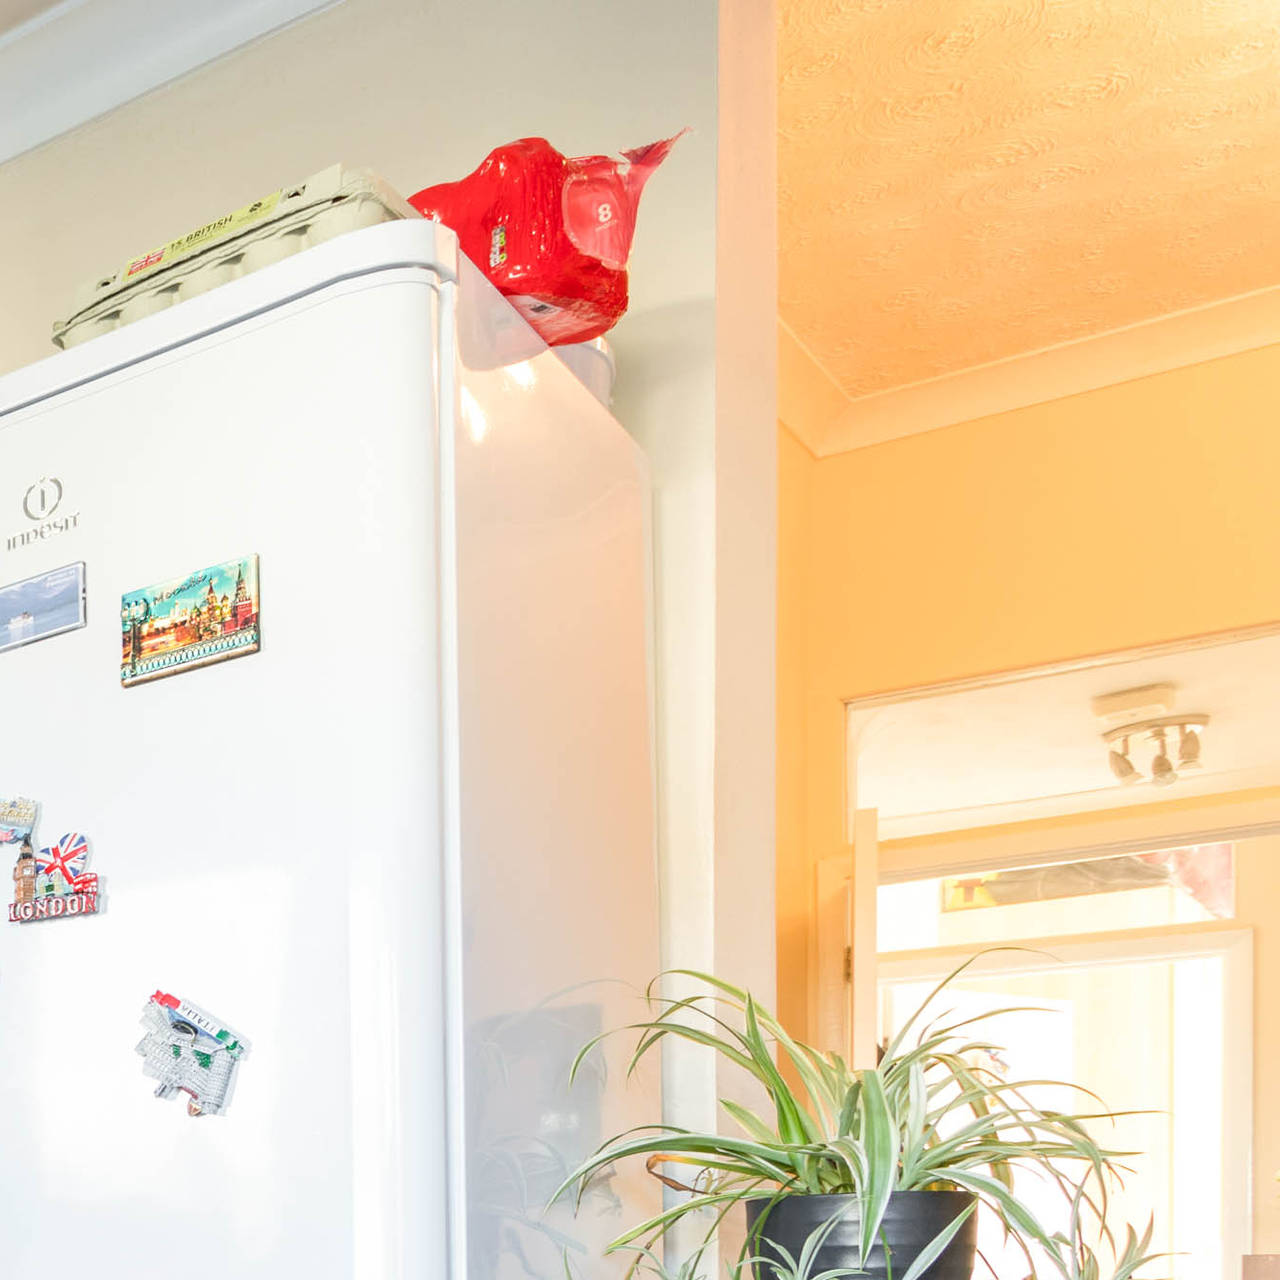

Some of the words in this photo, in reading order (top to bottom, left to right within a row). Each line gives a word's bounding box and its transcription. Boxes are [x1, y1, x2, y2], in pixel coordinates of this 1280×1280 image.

[597, 203, 613, 222] 8
[186, 215, 233, 242] BRITISH
[8, 894, 97, 922] LONDON
